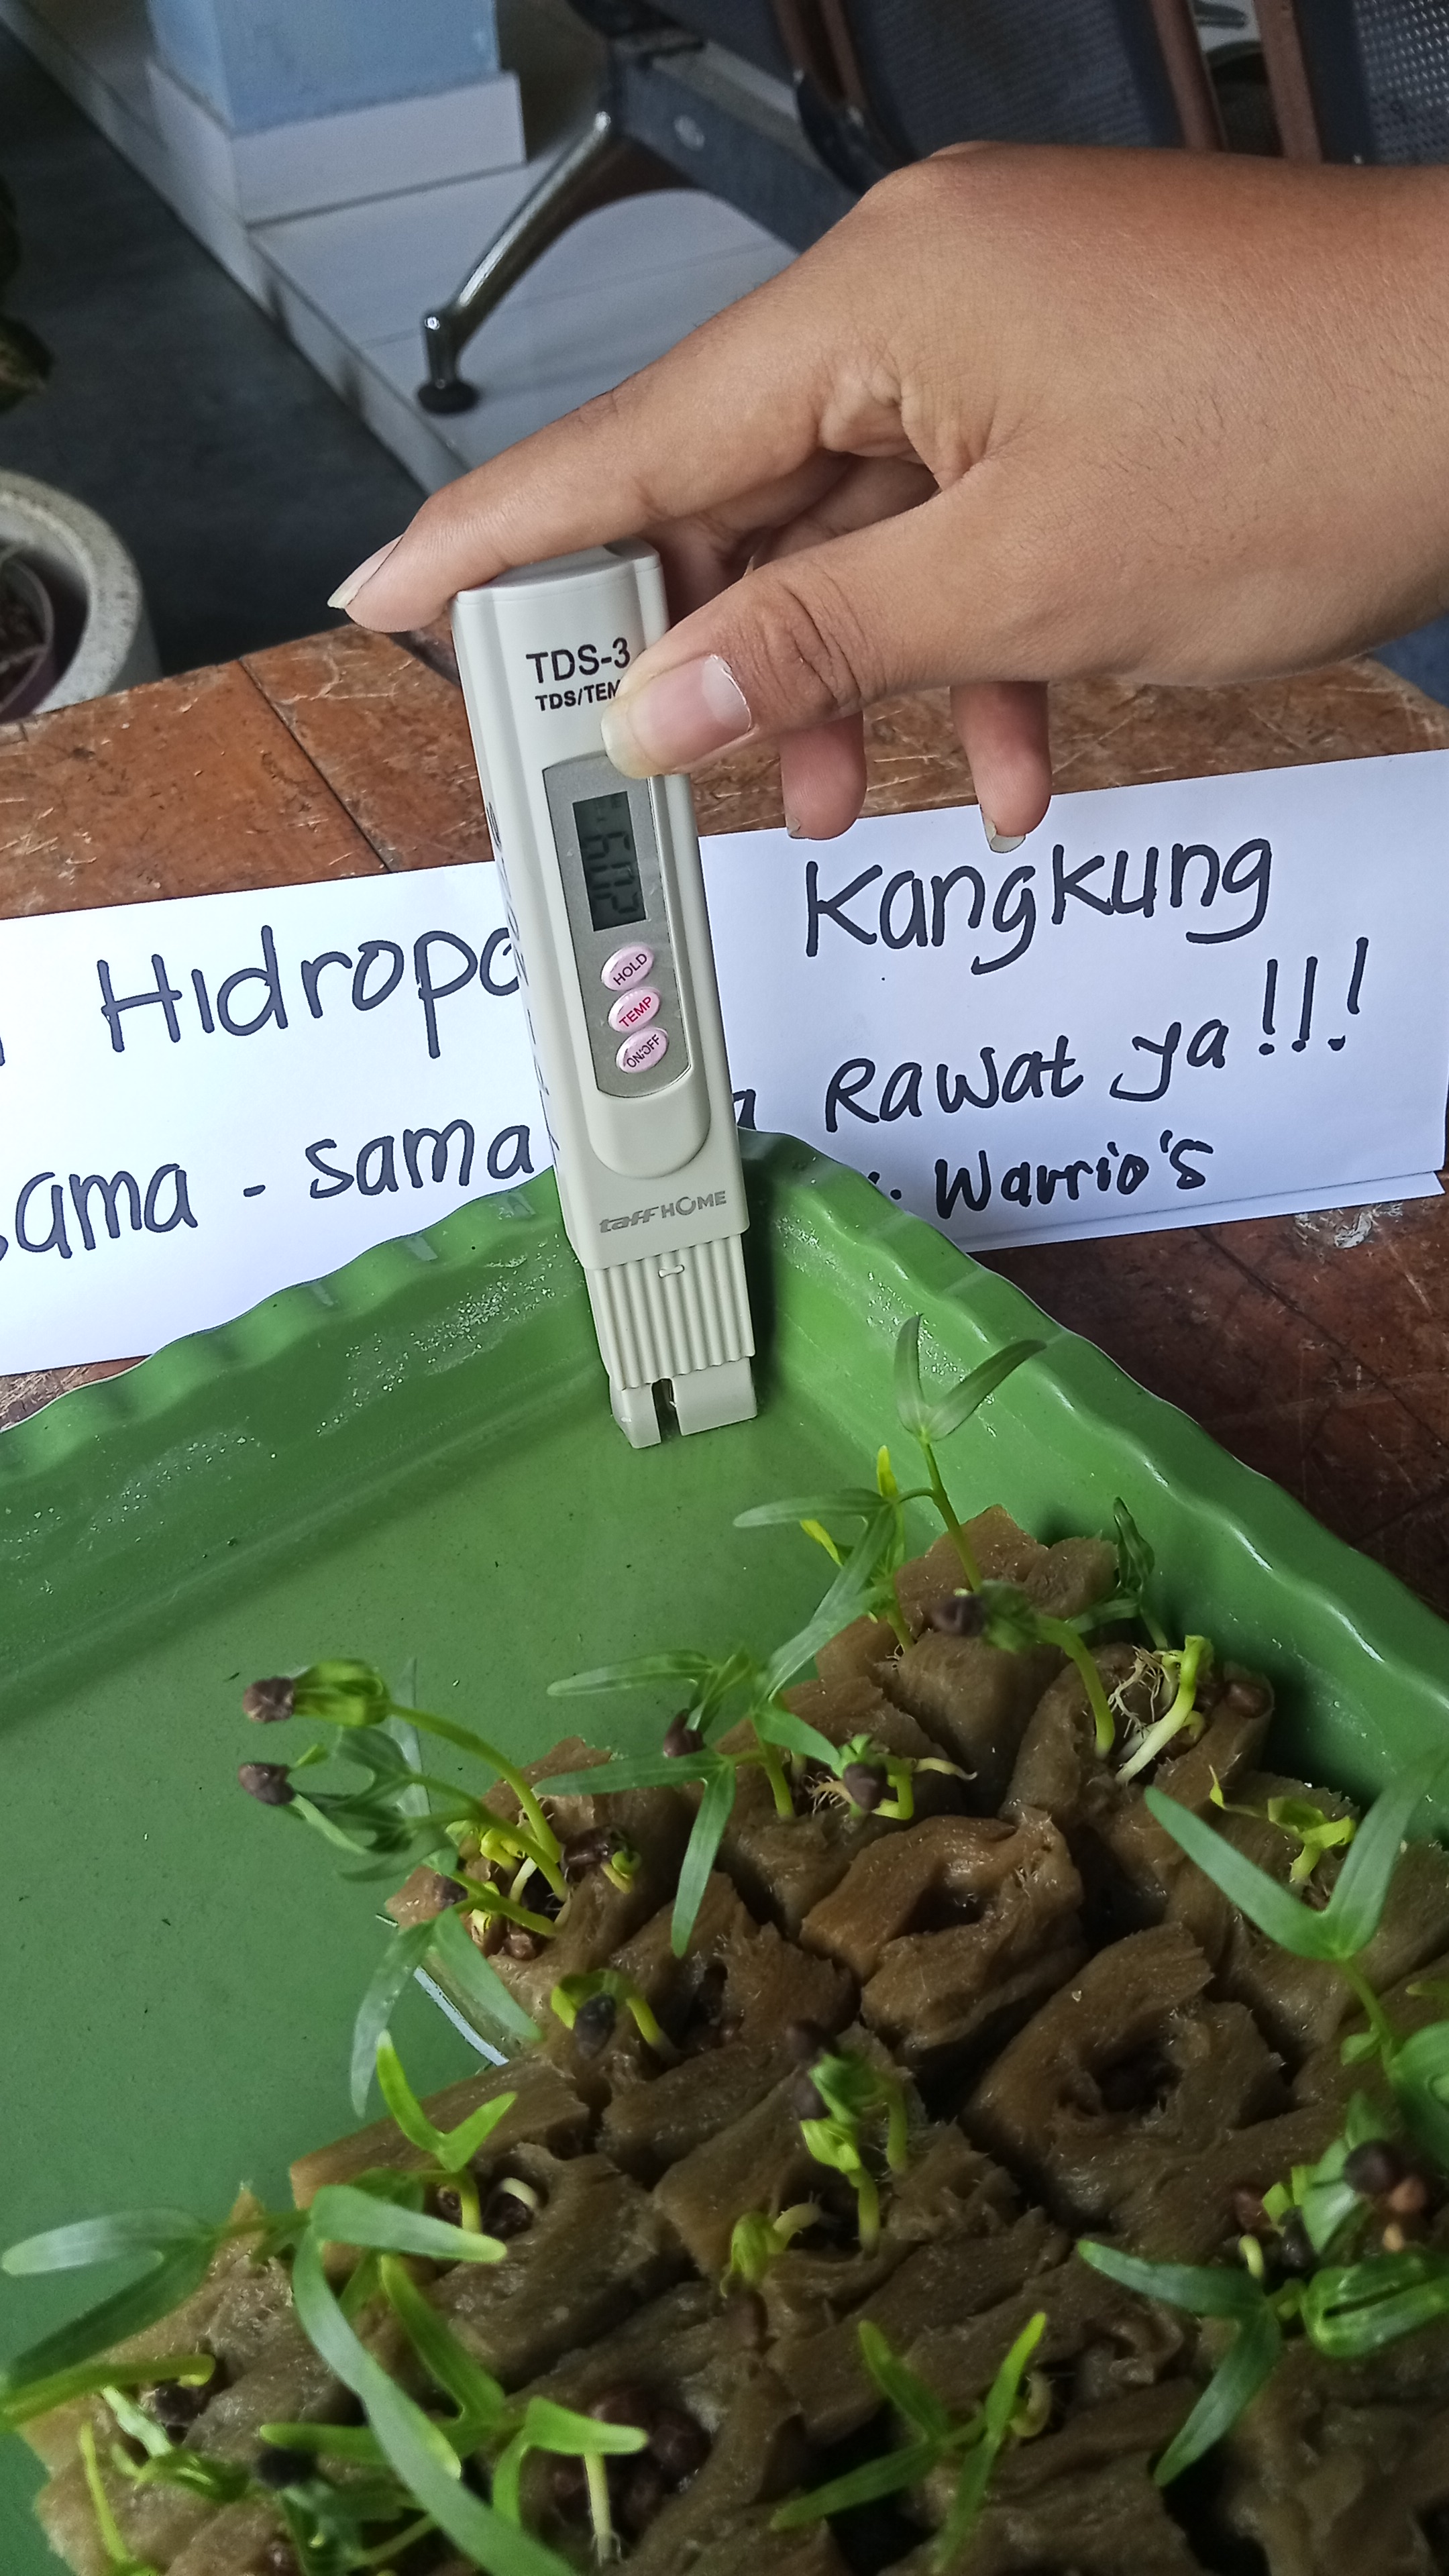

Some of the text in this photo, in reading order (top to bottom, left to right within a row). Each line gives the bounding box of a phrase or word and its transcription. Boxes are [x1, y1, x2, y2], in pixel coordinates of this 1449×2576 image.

[525, 637, 631, 684] TDS-3
[535, 679, 621, 711] TDS/TEM
[97, 838, 1272, 1059] Hidropo Kangkung
[612, 953, 648, 985] HOLD
[619, 996, 652, 1027] TEMP
[627, 1034, 660, 1068] ON/OFF
[305, 1120, 535, 1199] sama
